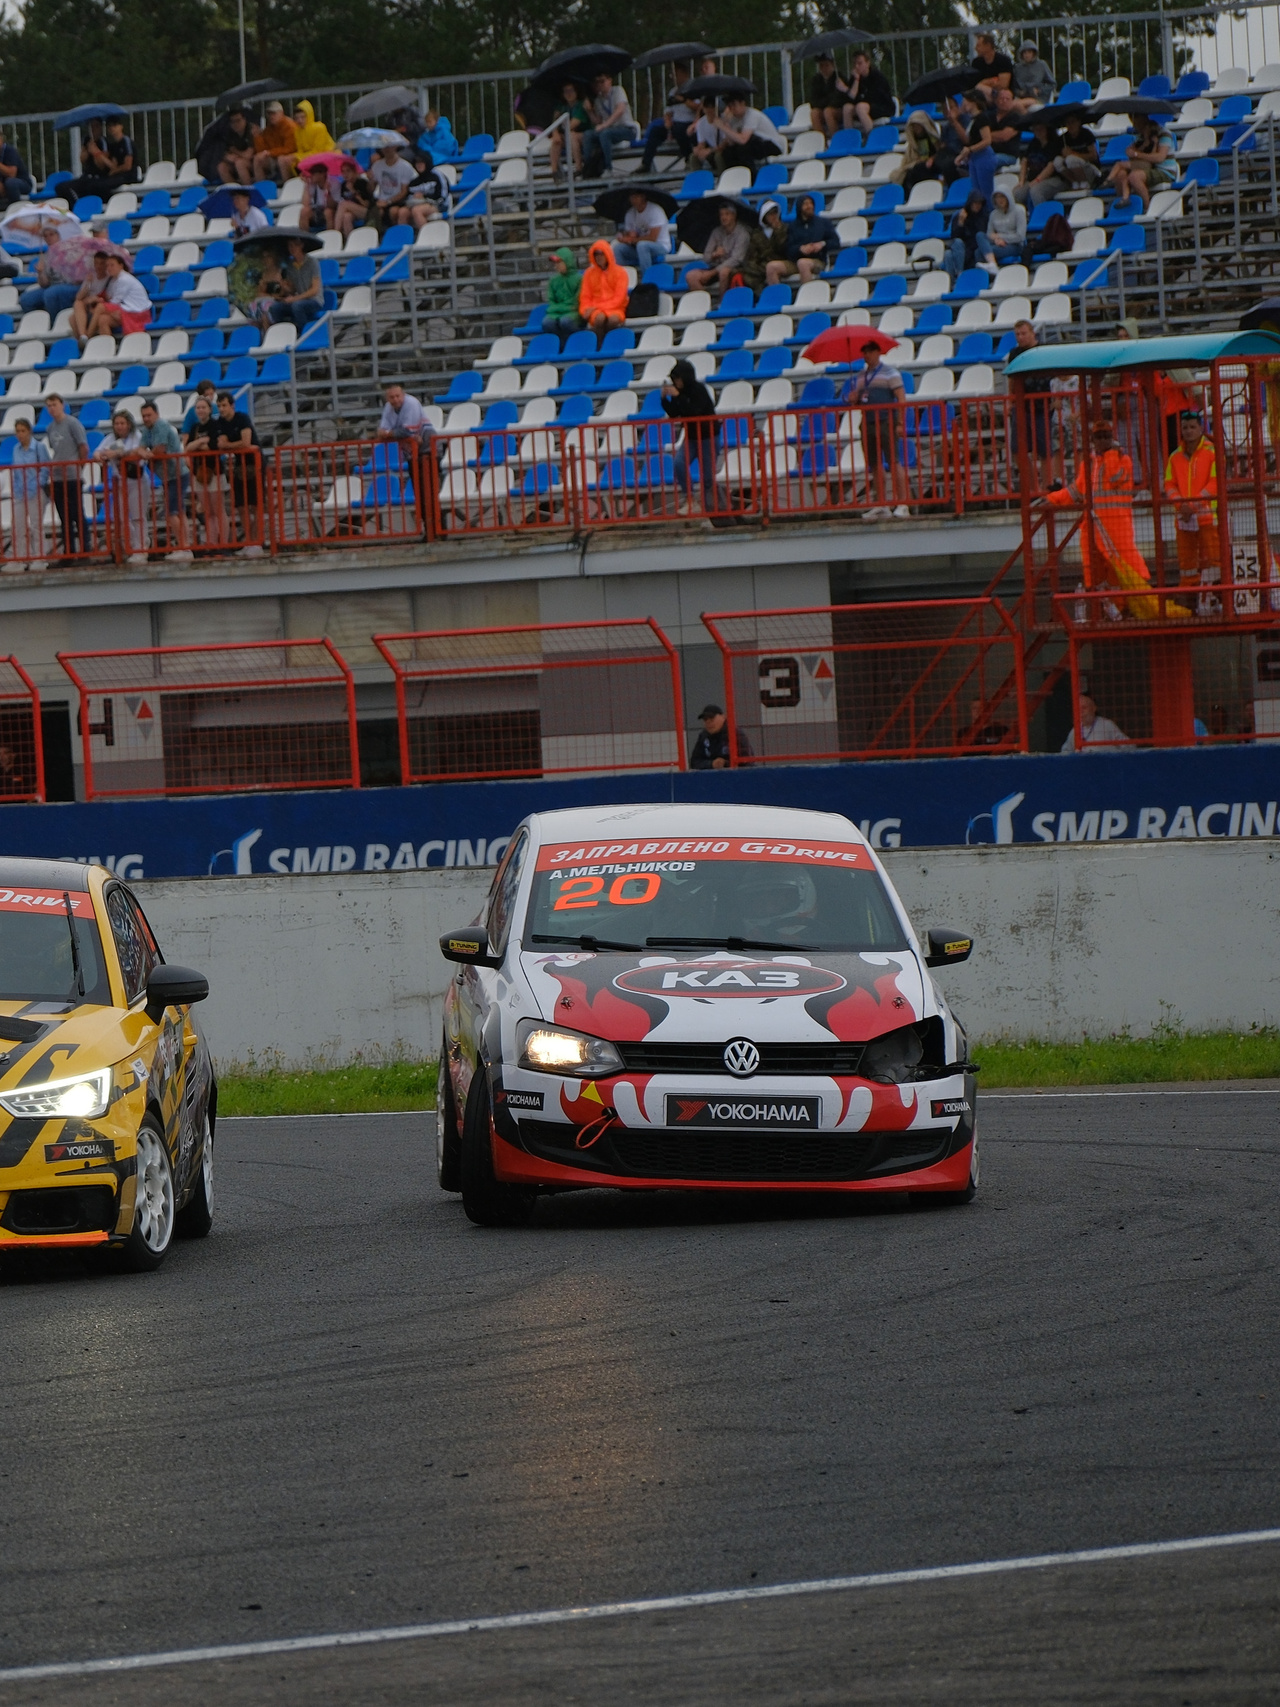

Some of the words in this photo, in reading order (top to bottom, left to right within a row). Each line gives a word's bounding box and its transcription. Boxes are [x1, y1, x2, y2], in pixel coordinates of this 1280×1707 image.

[758, 657, 801, 708] 3
[77, 697, 114, 746] 4
[1031, 809, 1128, 842] SMP
[1136, 801, 1280, 840] RACIN
[268, 845, 357, 874] SMP
[550, 841, 730, 864] ЗАПРАВЛЕНО
[549, 861, 696, 880] А.МЕЛЬНИКОВ
[553, 872, 662, 911] 20
[661, 970, 801, 989] КАЗ
[505, 1093, 541, 1107] YOKOHAMA
[943, 1100, 971, 1113] YOKOHAMA
[707, 1103, 811, 1122] YOKOHAMA
[66, 1144, 104, 1156] YOKOHA
